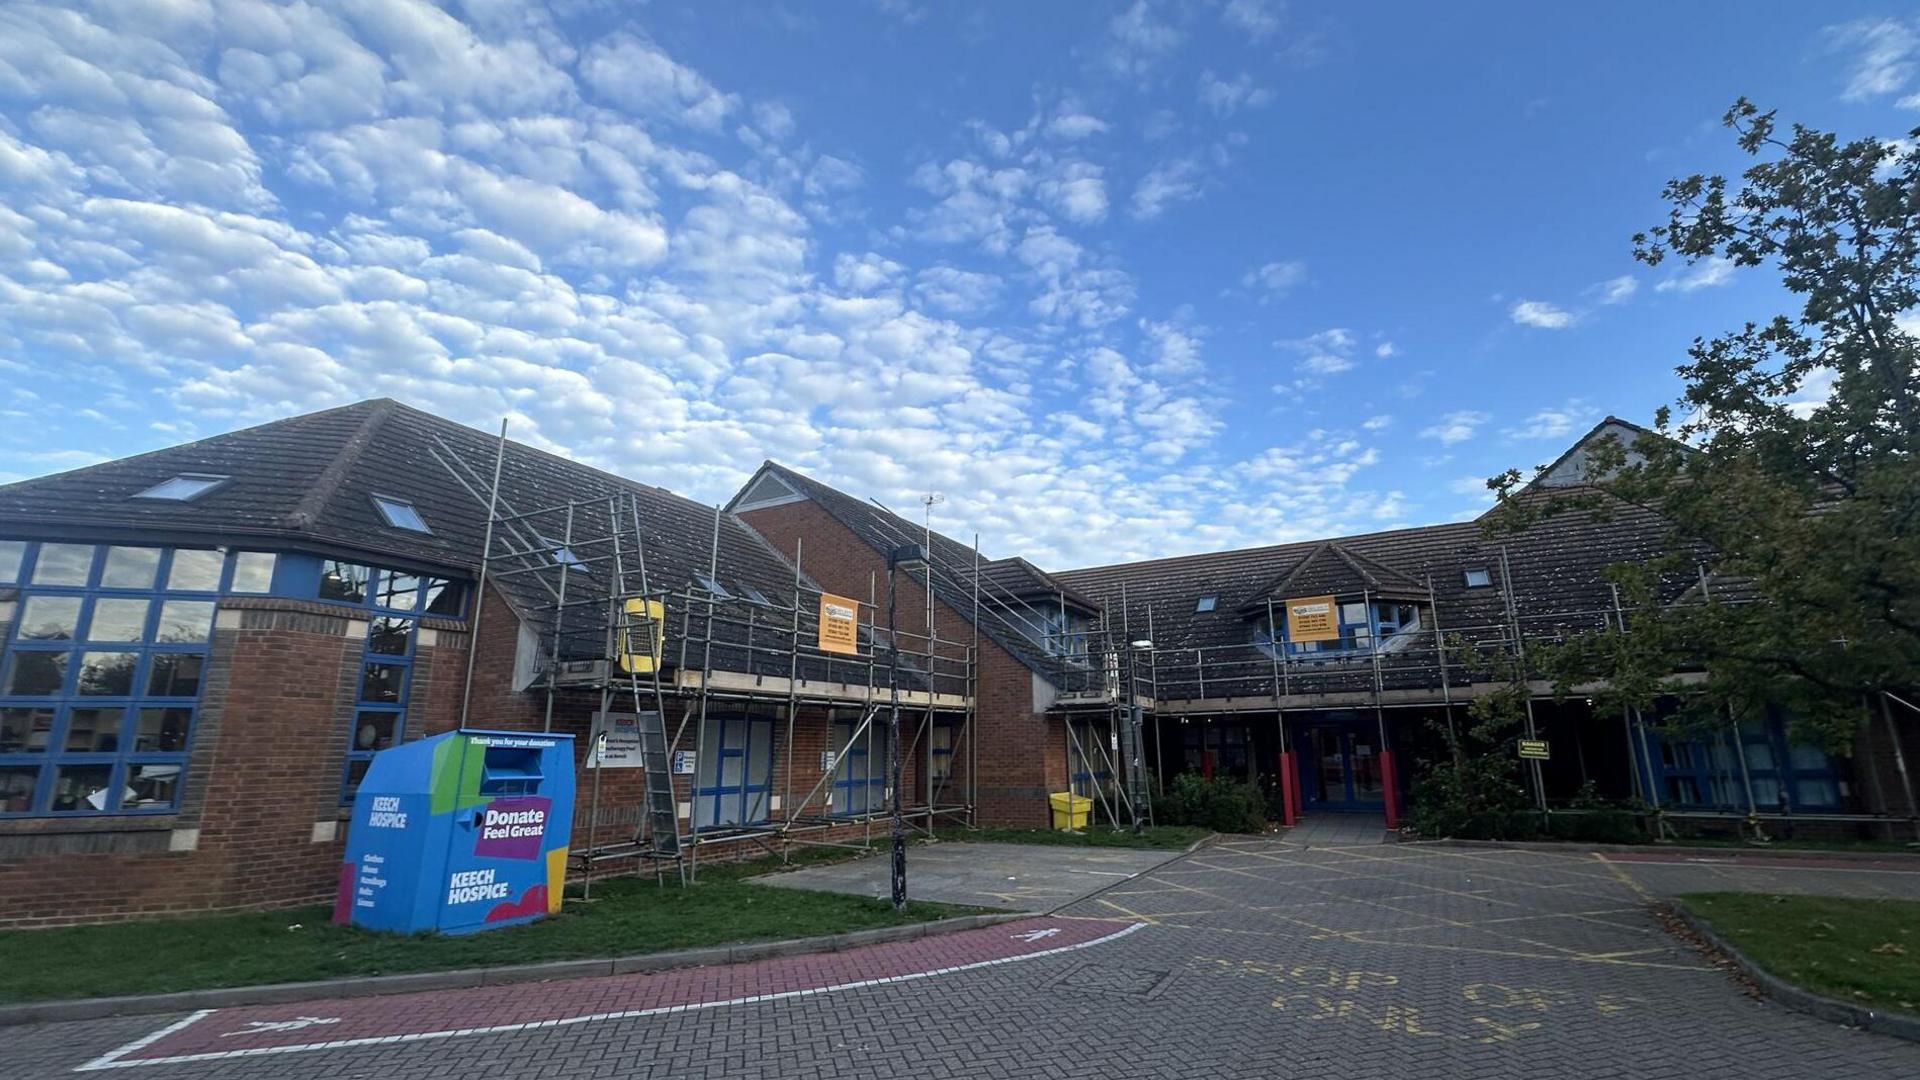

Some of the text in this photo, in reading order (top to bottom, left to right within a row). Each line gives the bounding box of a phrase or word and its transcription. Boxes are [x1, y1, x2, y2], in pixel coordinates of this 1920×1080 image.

[471, 737, 555, 748] Thank you for your donation
[372, 797, 400, 812] KEECH
[369, 812, 407, 828] HOSPICE
[485, 809, 544, 826] Donate
[483, 825, 543, 840] Feel Great
[451, 869, 495, 889] KEECH
[448, 882, 508, 905] HOSPICE
